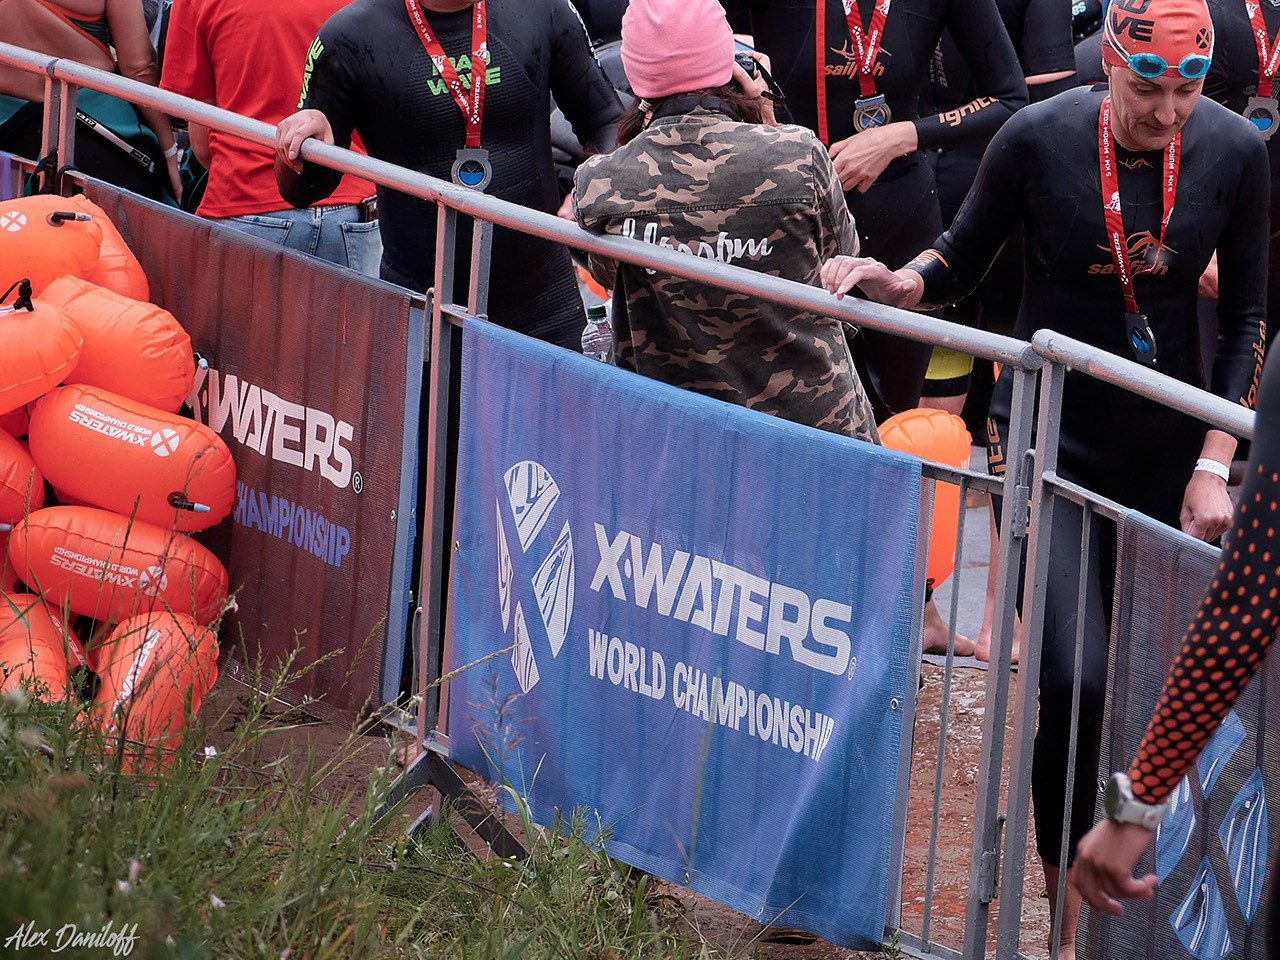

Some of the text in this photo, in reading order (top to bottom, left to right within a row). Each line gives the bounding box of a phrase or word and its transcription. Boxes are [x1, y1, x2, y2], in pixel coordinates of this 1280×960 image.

[1109, 11, 1155, 43] VE
[1102, 108, 1110, 126] 2025
[1103, 126, 1111, 154] MUROM
[1105, 160, 1112, 172] KM
[1167, 176, 1174, 187] KM
[588, 627, 835, 763] WORLD CHAMPIONSHIP
